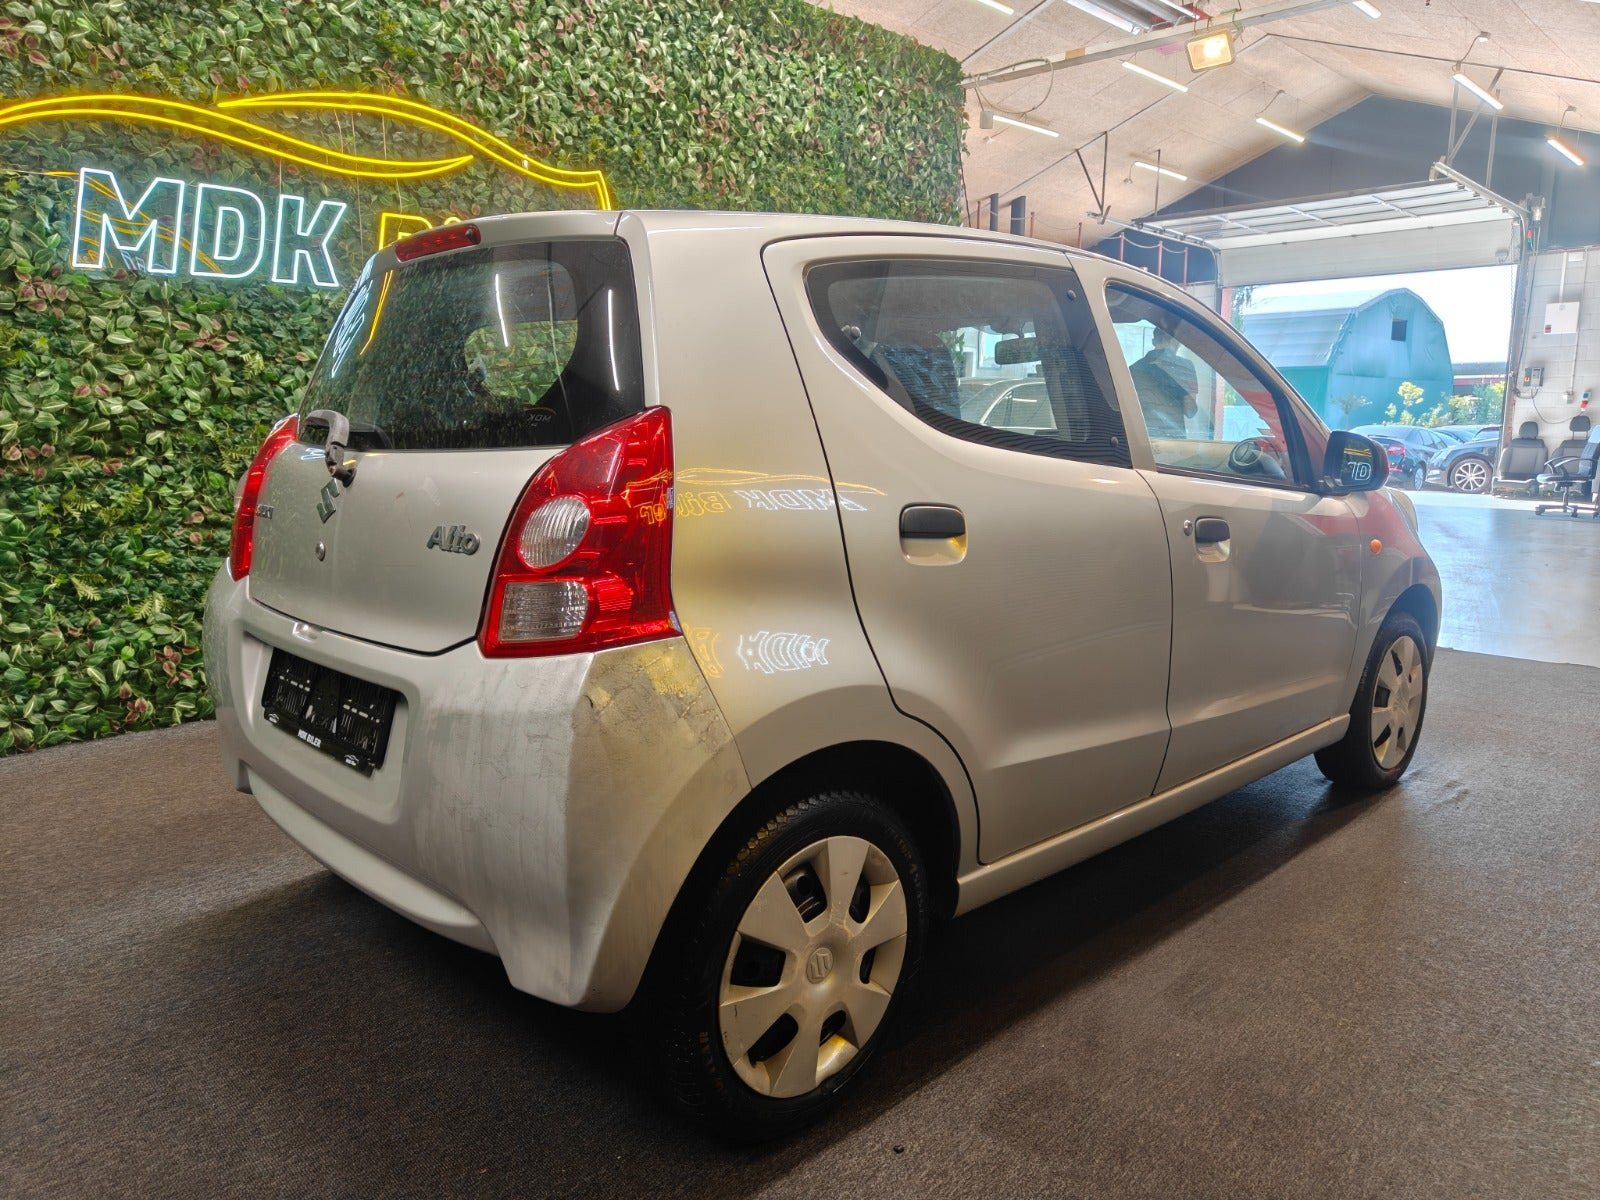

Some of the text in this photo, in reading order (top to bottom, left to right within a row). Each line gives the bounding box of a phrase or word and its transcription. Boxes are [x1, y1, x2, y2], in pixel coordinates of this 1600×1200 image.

[72, 167, 347, 287] MDK
[426, 524, 481, 556] Alto
[306, 733, 322, 749] BILER
